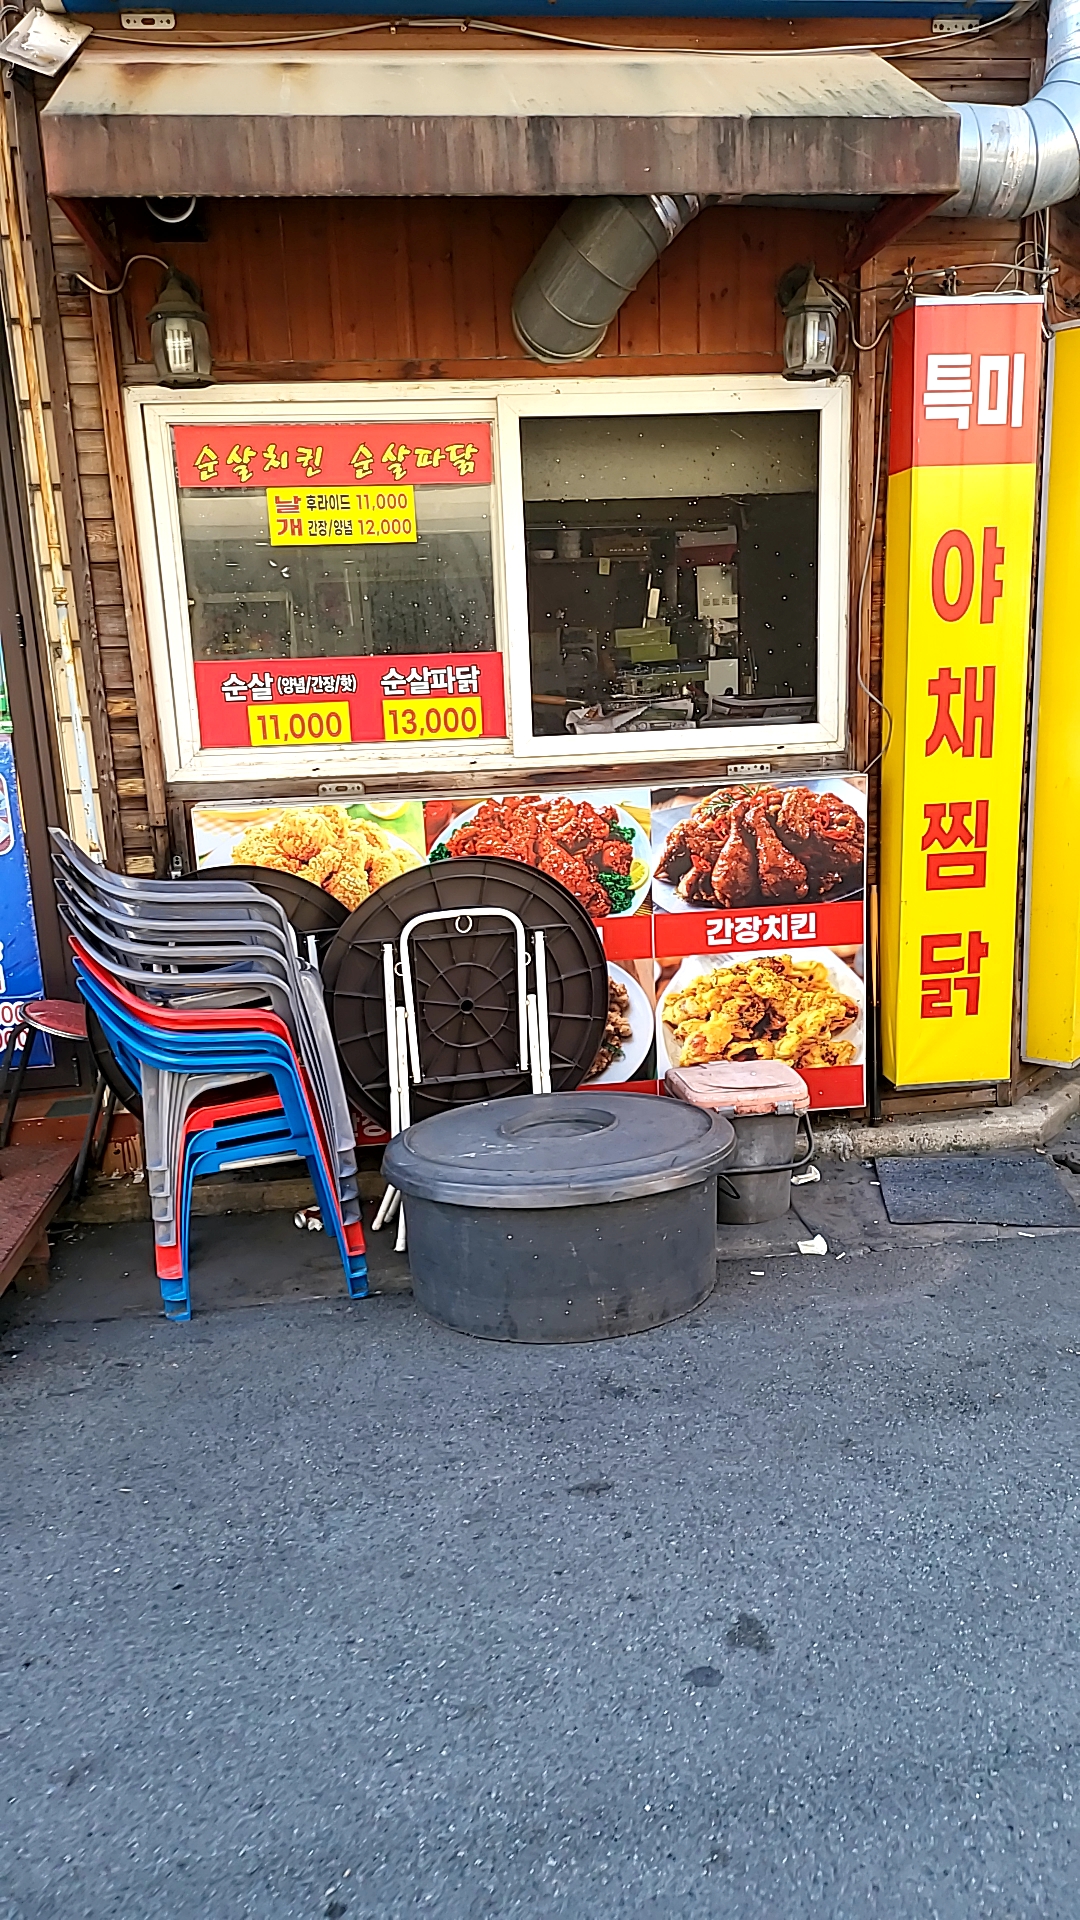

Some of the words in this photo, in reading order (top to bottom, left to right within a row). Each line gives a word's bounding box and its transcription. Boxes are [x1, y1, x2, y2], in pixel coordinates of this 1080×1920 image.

[923, 353, 1026, 430] 특미
[193, 443, 323, 483] 순살치킨
[348, 441, 480, 481] 순살파닭
[306, 494, 351, 511] 후라이드
[356, 493, 408, 511] 11,000
[308, 519, 353, 537] 간장/양념
[357, 518, 412, 537] 12,000
[221, 672, 275, 702] 순살
[380, 664, 482, 696] 순살파닭
[256, 711, 343, 742] 11,000
[388, 706, 478, 737] 13,000
[706, 912, 817, 946] 간장치킨
